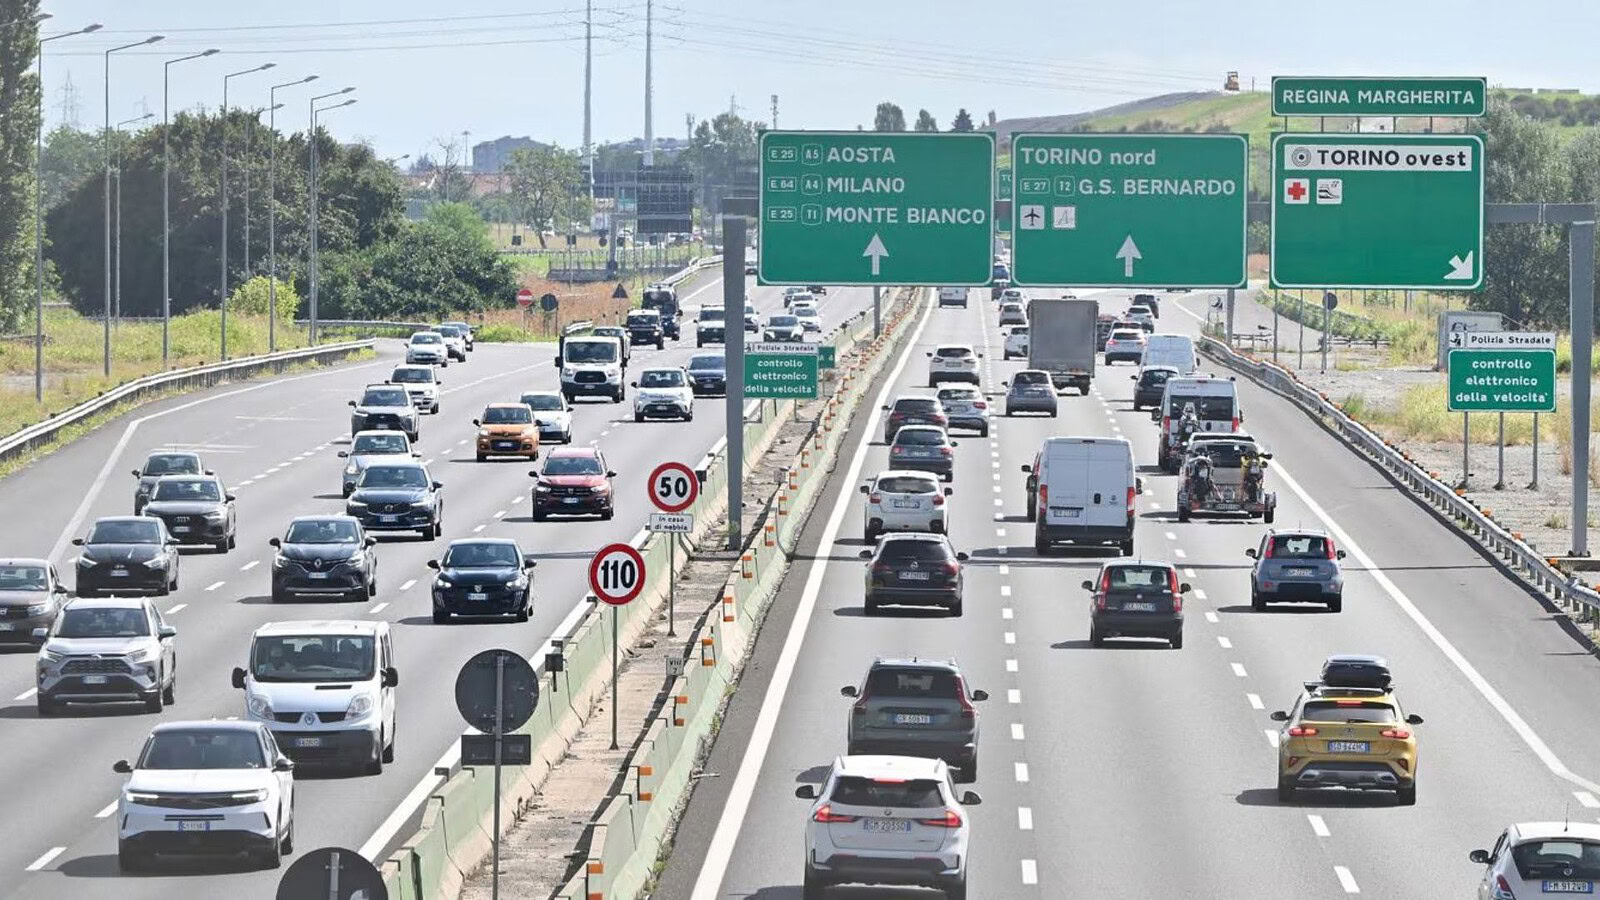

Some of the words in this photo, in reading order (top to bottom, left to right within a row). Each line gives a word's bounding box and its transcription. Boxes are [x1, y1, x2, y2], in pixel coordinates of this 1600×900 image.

[1283, 89, 1350, 104] REGINA
[1358, 90, 1475, 105] MARGHERITA
[771, 150, 777, 159] E
[781, 150, 794, 159] 25
[805, 150, 819, 159] A5
[827, 147, 896, 163] AOSTA
[1020, 147, 1102, 165] TORINO
[1110, 149, 1156, 165] nord
[1317, 149, 1400, 166] TORINO
[1405, 150, 1467, 167] ovest
[771, 180, 777, 189] E
[805, 180, 818, 190] A4
[827, 177, 905, 193] MILANO
[1023, 181, 1031, 191] E
[1033, 181, 1047, 191] 27
[1079, 179, 1116, 195] G.S.
[1123, 179, 1235, 195] BERNARDO
[771, 210, 777, 219] E
[780, 210, 794, 219] 25
[826, 207, 898, 223] MONTE
[907, 208, 985, 224] BIANCO
[1471, 335, 1504, 344] Polizia
[1508, 335, 1551, 344] Stradale
[757, 359, 803, 367] controllo
[1472, 359, 1532, 369] controllo
[752, 371, 807, 380] elettronico
[1465, 375, 1538, 386] elettronico
[744, 385, 769, 393] della
[1455, 392, 1487, 402] della
[658, 476, 688, 498] 50
[600, 559, 636, 590] 110
